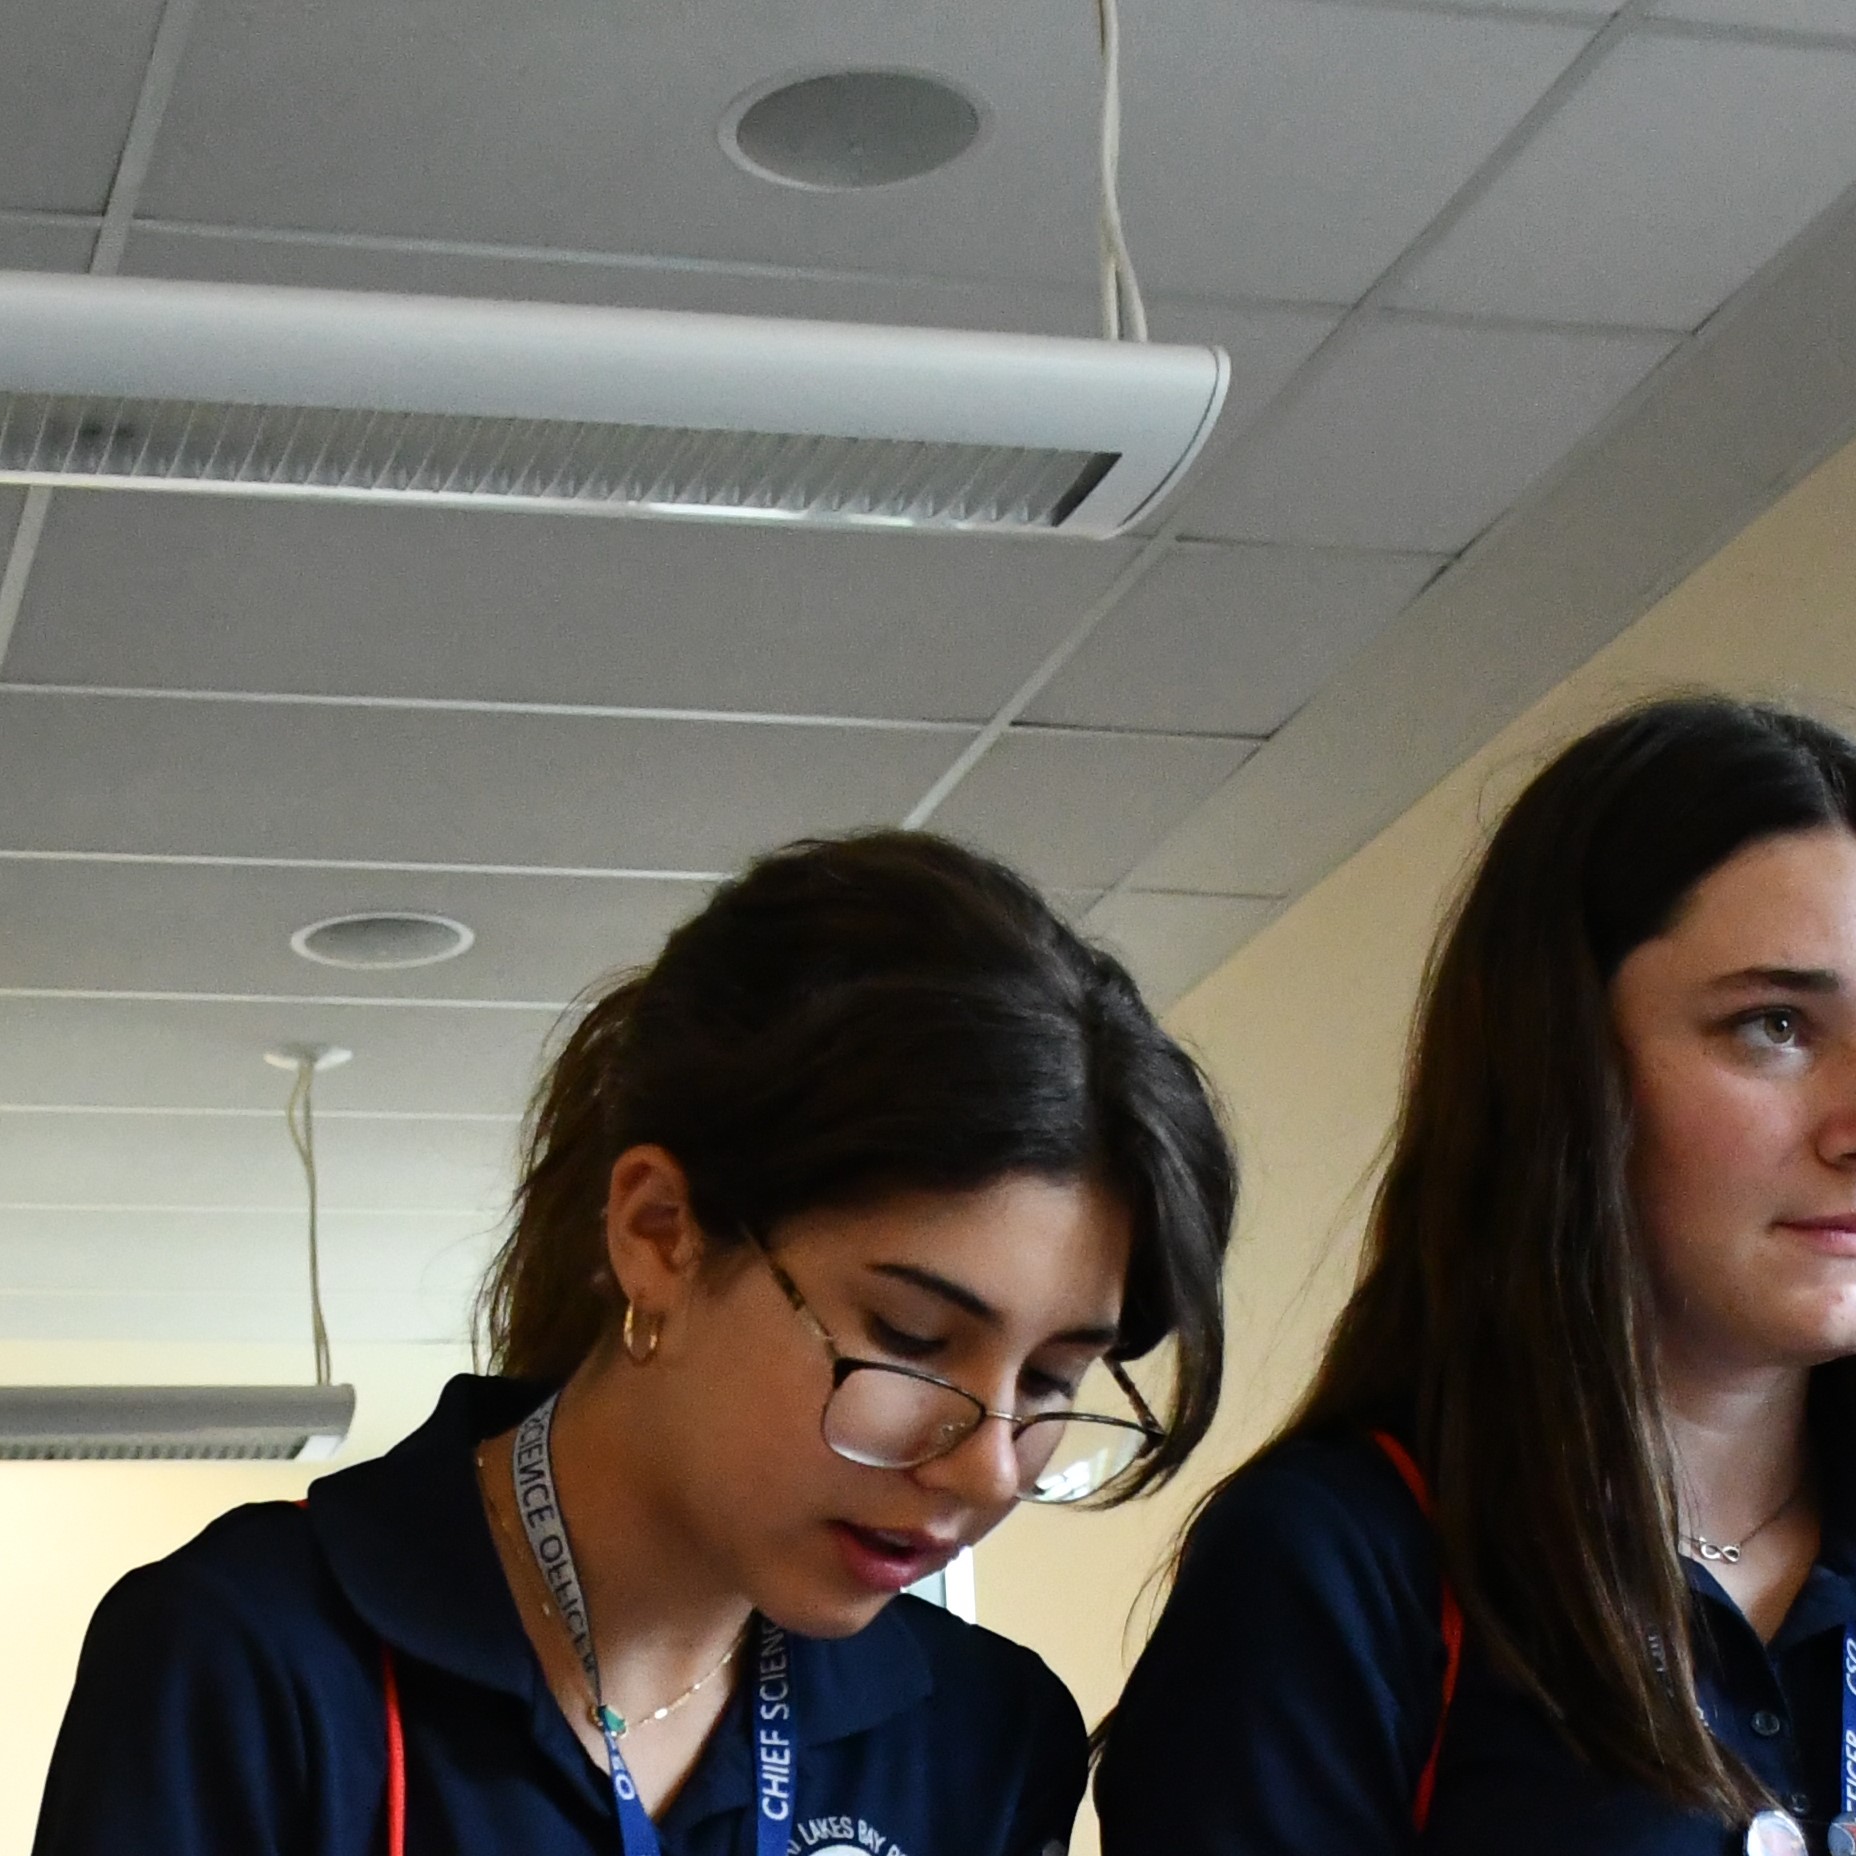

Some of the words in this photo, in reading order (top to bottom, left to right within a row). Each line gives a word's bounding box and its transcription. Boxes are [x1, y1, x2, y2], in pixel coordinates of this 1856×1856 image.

[759, 1625, 791, 1720] SCIEN
[760, 1729, 792, 1822] CHIEF
[798, 1816, 855, 1847] LAKES
[857, 1819, 887, 1855] BAY
